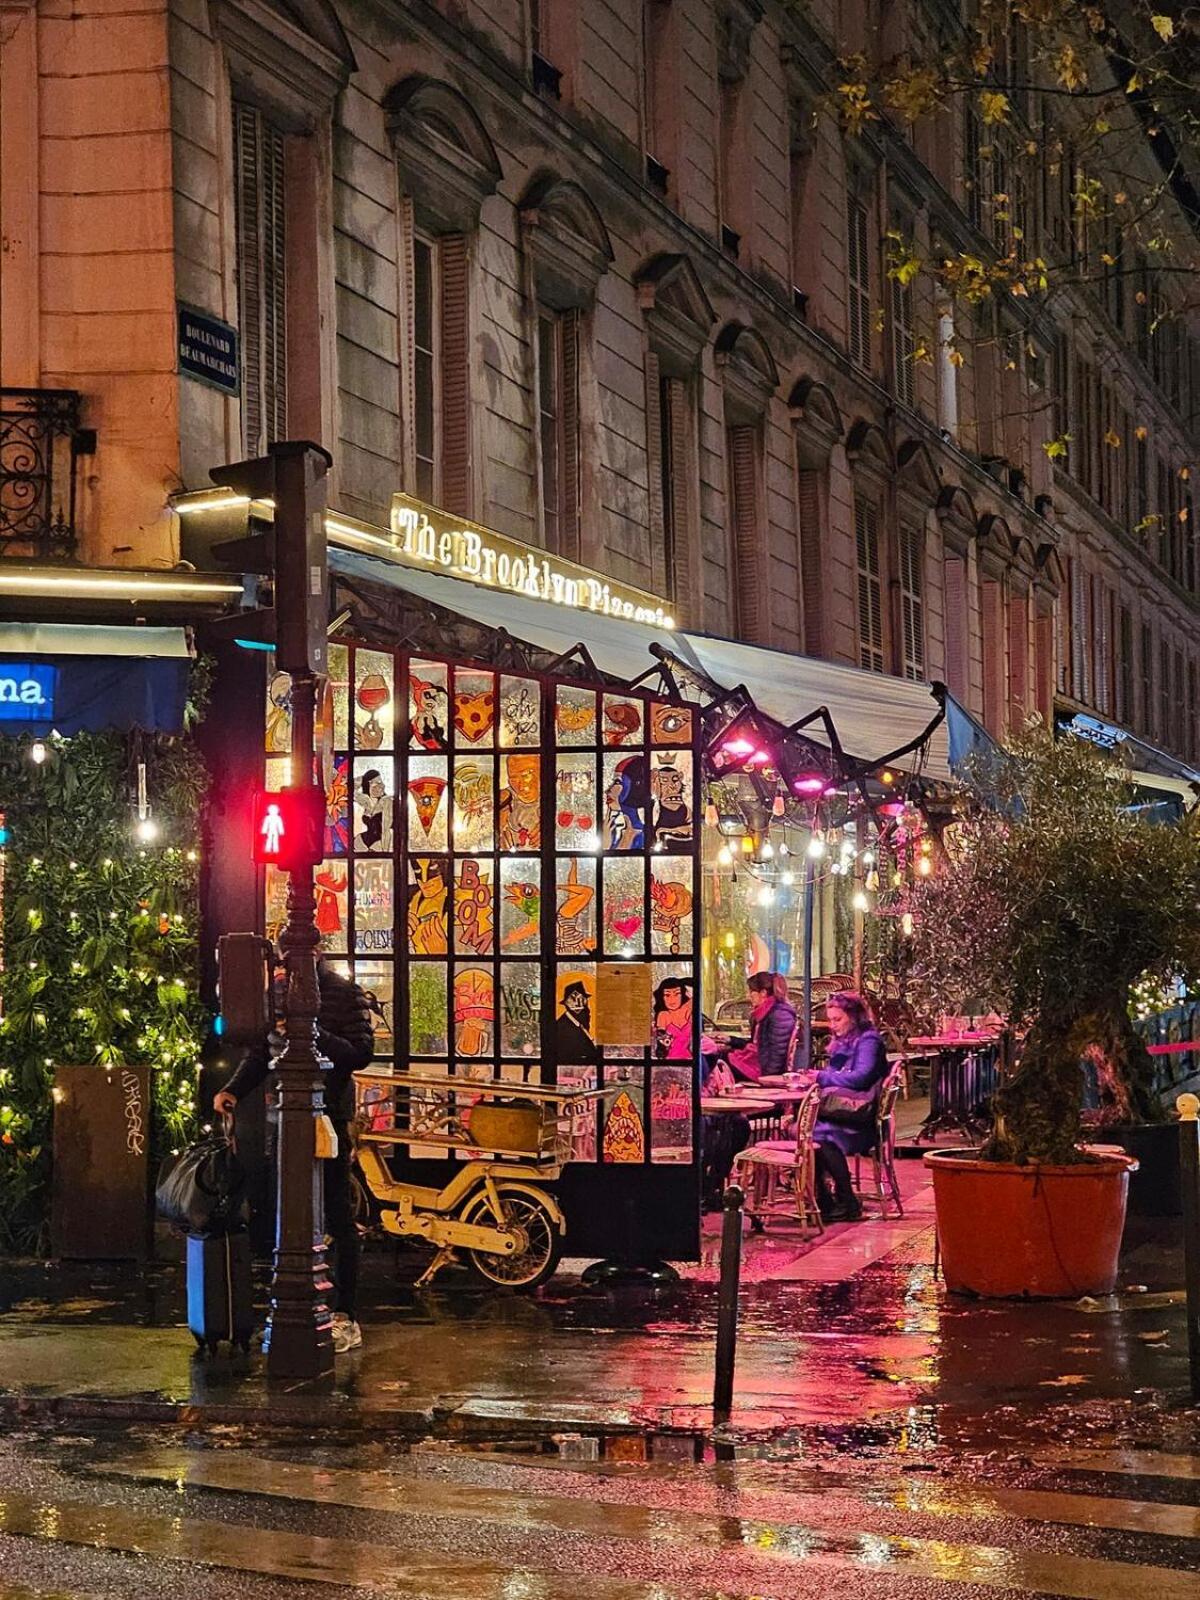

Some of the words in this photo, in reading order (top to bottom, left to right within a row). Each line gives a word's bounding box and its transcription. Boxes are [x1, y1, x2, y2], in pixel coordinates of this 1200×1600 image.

[186, 324, 230, 353] BOULEVARD
[398, 508, 452, 566] The
[462, 530, 578, 607] Brooklyn
